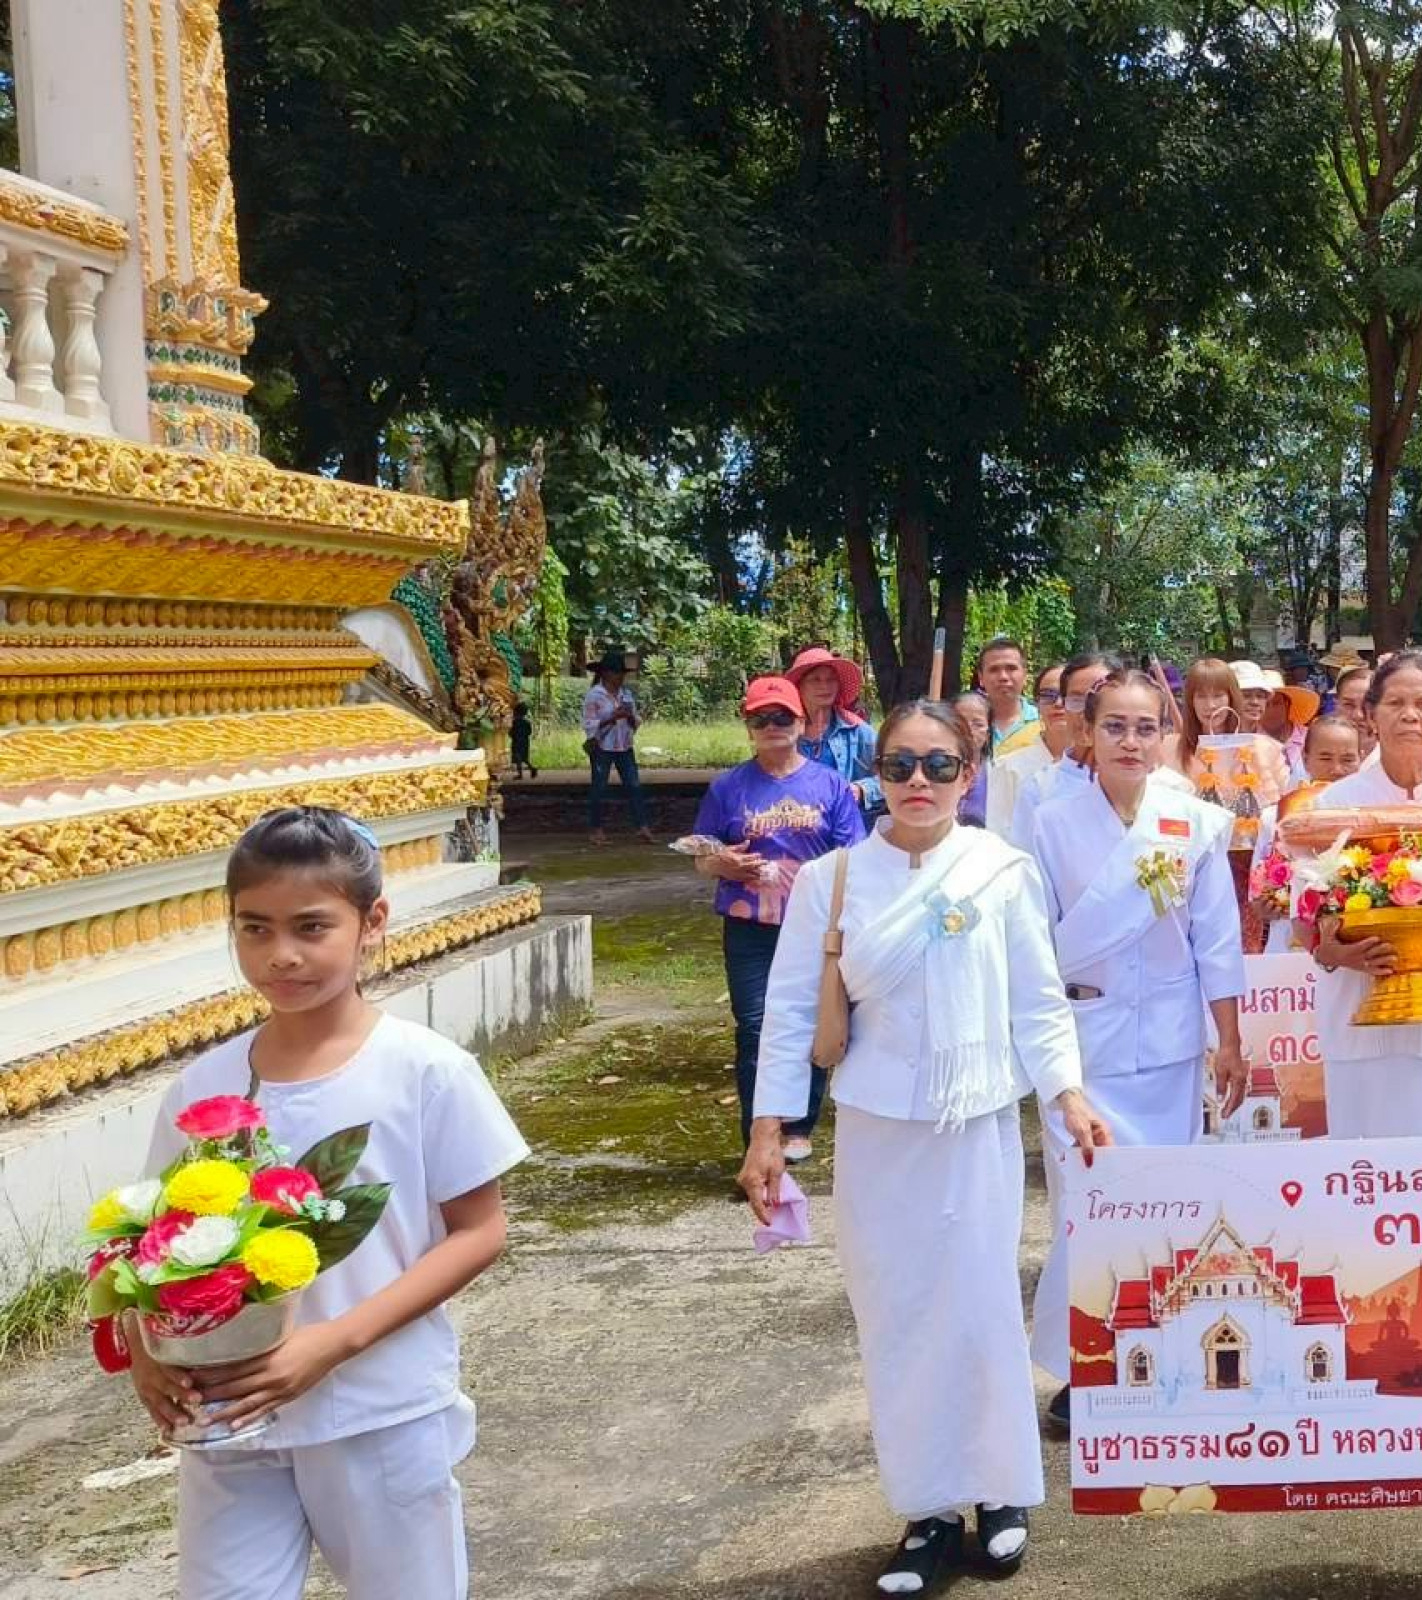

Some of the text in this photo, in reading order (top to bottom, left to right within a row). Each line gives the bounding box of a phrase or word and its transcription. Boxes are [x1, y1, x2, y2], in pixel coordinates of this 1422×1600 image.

[1087, 1189, 1202, 1220] โครงการ
[1281, 1484, 1317, 1506] โดย
